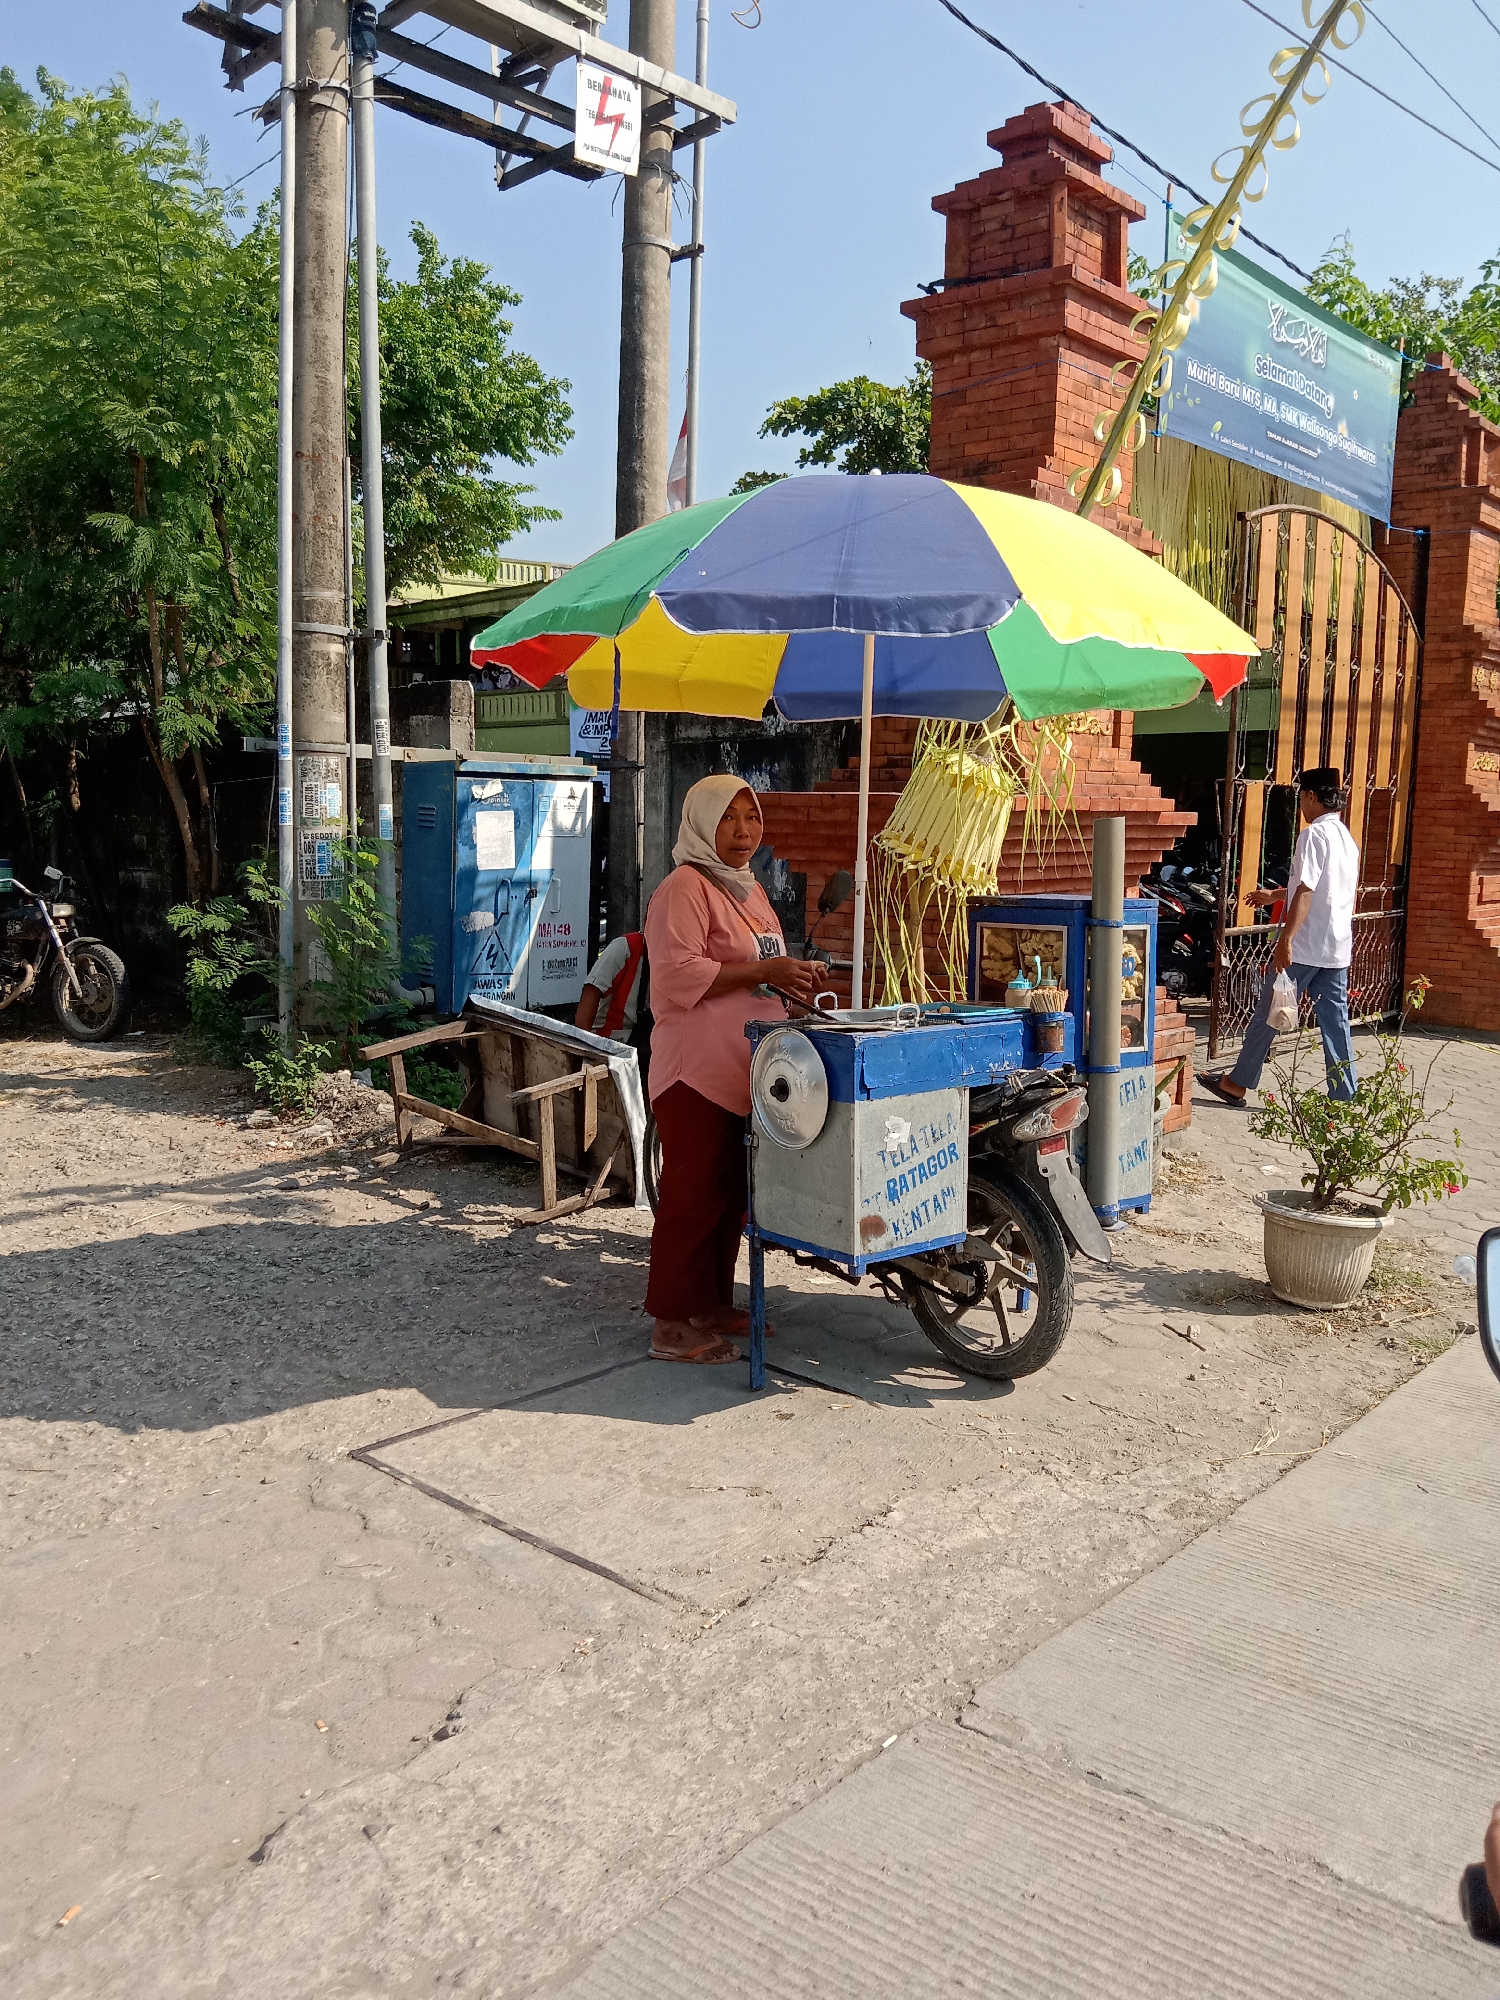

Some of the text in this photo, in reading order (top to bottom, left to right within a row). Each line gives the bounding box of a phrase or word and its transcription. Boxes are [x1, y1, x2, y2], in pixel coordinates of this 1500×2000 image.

[587, 78, 632, 103] BERBAHAYA
[1187, 357, 1377, 467] Murid Baru MTS, MA, SMK Walisongo Sugihwaras
[1255, 354, 1333, 419] Selamat Datang
[473, 978, 503, 990] AWAS
[886, 1142, 960, 1202] BATAGOR
